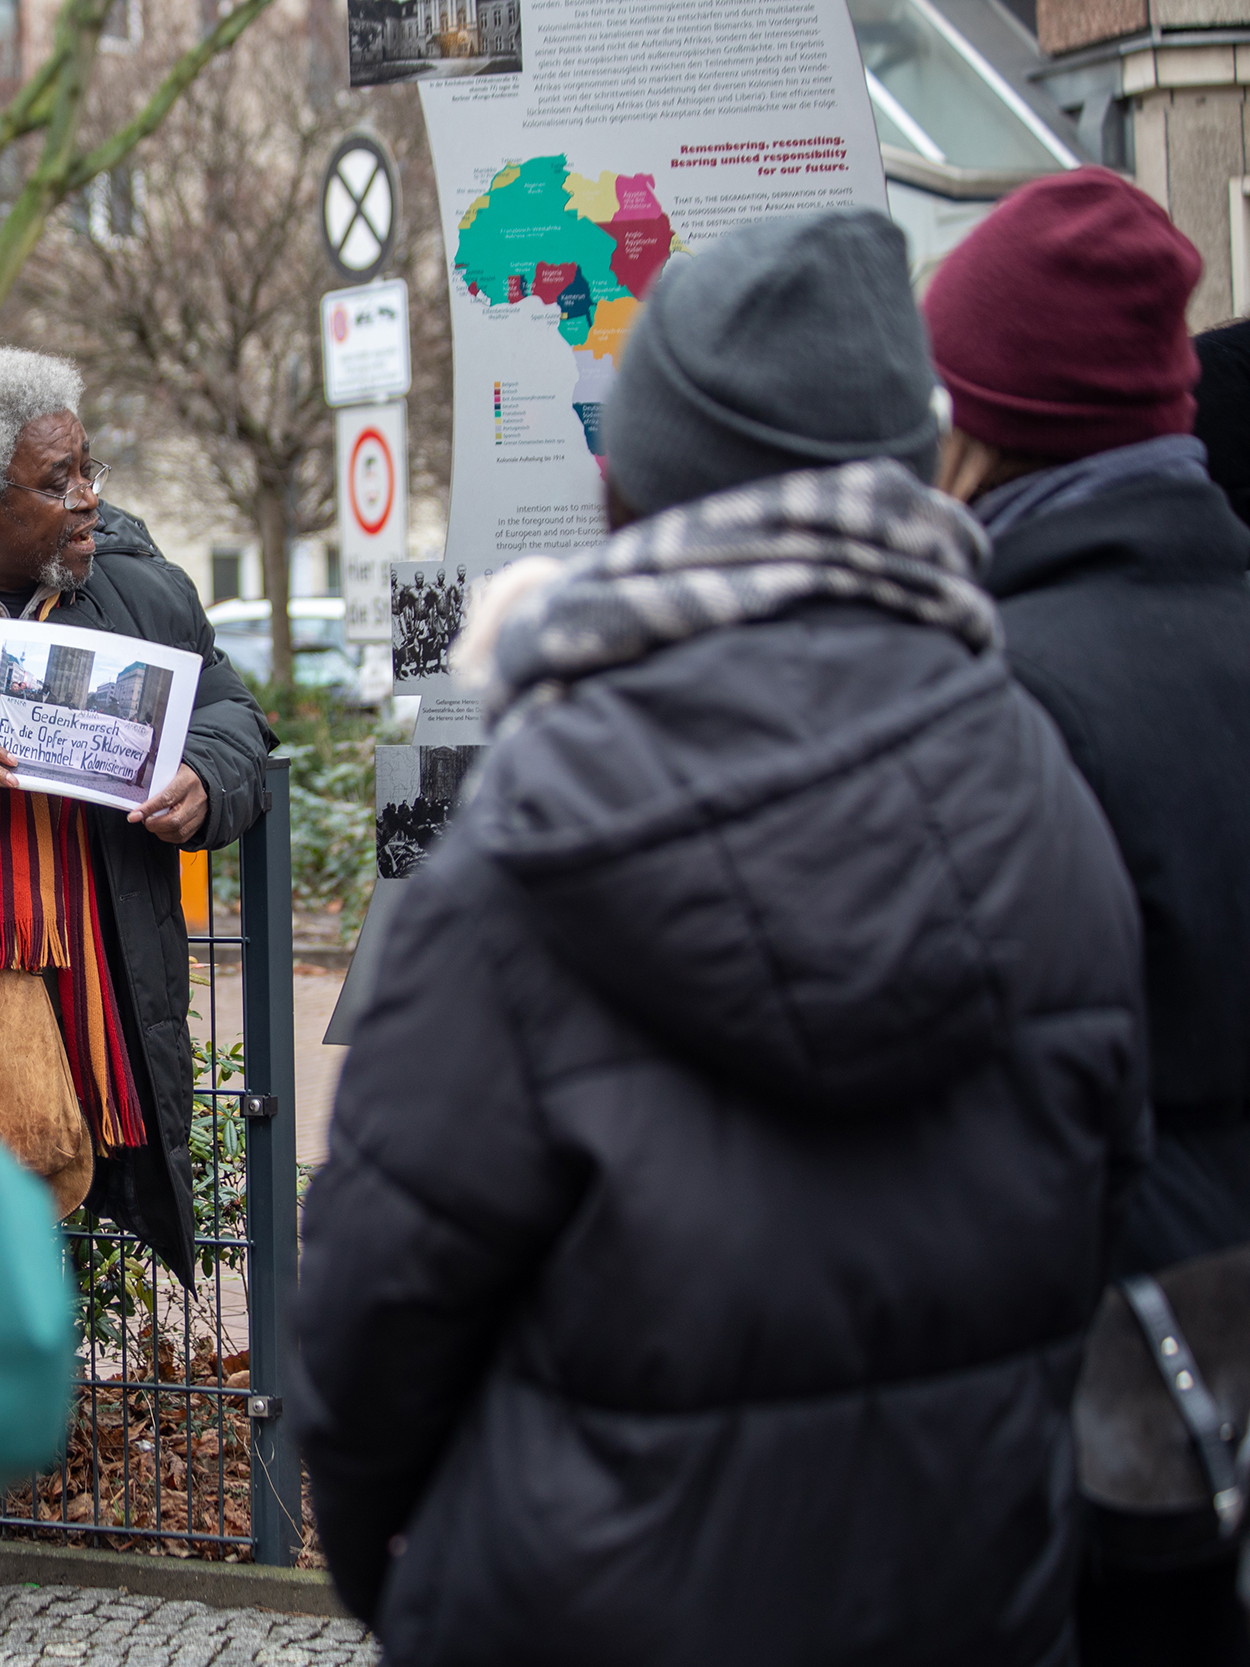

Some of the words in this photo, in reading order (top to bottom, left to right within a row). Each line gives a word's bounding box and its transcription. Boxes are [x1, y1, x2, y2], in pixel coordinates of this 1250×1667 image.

[543, 34, 587, 43] Abkommen
[599, 30, 644, 39] kanalisieren
[662, 26, 674, 34] die
[676, 24, 711, 33] Intention
[714, 20, 754, 31] Bismarcks.
[756, 19, 767, 27] Im
[769, 15, 818, 27] Vordergrund
[606, 19, 627, 27] Diese
[725, 9, 739, 18] und
[741, 7, 763, 16] durch
[535, 48, 556, 56] seiner
[558, 45, 582, 54] Politik
[584, 43, 605, 52] stand
[607, 42, 626, 51] nicht
[628, 41, 640, 49] die
[641, 38, 681, 48] Aufteilung
[716, 34, 747, 43] sondern
[749, 32, 763, 40] der
[538, 58, 560, 70] gleich
[562, 58, 575, 66] der
[577, 54, 628, 66] europäischen
[630, 52, 645, 61] und
[777, 43, 787, 51] Im
[790, 40, 825, 52] Ergebnis
[532, 70, 556, 79] wurde
[558, 70, 571, 78] der
[573, 64, 648, 77] Interessenausgleich
[650, 62, 685, 71] zwischen
[687, 61, 702, 69] den
[704, 58, 754, 68] Teilnehmern
[755, 54, 782, 67] jedoch
[784, 53, 797, 62] auf
[800, 52, 828, 61] Kosten
[534, 82, 561, 91] Afrikas
[563, 79, 618, 91] vorgenommen
[620, 76, 636, 85] und
[649, 74, 682, 83] markiert
[684, 73, 696, 81] die
[698, 71, 739, 80] Konferenz
[741, 67, 779, 77] unstreitig
[781, 66, 796, 74] den
[798, 63, 830, 73] Wende-
[527, 105, 571, 115] lückenlosen
[573, 102, 614, 112] Aufteilung
[616, 100, 643, 109] Afrikas
[661, 97, 674, 106] auf
[717, 93, 733, 102] und
[770, 91, 788, 99] Eine
[789, 88, 836, 97] effizientere
[538, 93, 560, 105] punkt
[579, 92, 591, 100] der
[593, 89, 645, 99] schrittweisen
[647, 85, 696, 95] Ausdehnung
[698, 84, 711, 92] der
[712, 82, 746, 91] diversen
[748, 79, 783, 88] Kolonien
[785, 78, 799, 86] hin
[812, 76, 833, 84] einer
[522, 117, 583, 127] Kolonialisierung
[585, 114, 608, 123] durch
[609, 111, 658, 124] gegenseitige
[660, 109, 701, 120] Akzeptanz
[702, 107, 715, 115] der
[718, 103, 779, 114] Kolonialmächte
[799, 101, 811, 109] die
[813, 100, 838, 110] Folge.
[680, 142, 769, 154] Remembering,
[772, 137, 845, 148] reconciling.
[671, 158, 717, 168] Bearing
[721, 154, 760, 165] united
[763, 150, 847, 163] responsibility
[758, 167, 777, 175] for
[805, 164, 849, 173] future.
[507, 517, 520, 525] the
[522, 516, 564, 526] foreground
[576, 515, 587, 523] his
[495, 530, 504, 538] of
[506, 530, 541, 539] European
[544, 528, 558, 536] and
[496, 541, 527, 551] through
[544, 540, 571, 548] mutual
[19, 725, 33, 740] die
[38, 726, 68, 749] Opfer
[71, 739, 88, 749] von
